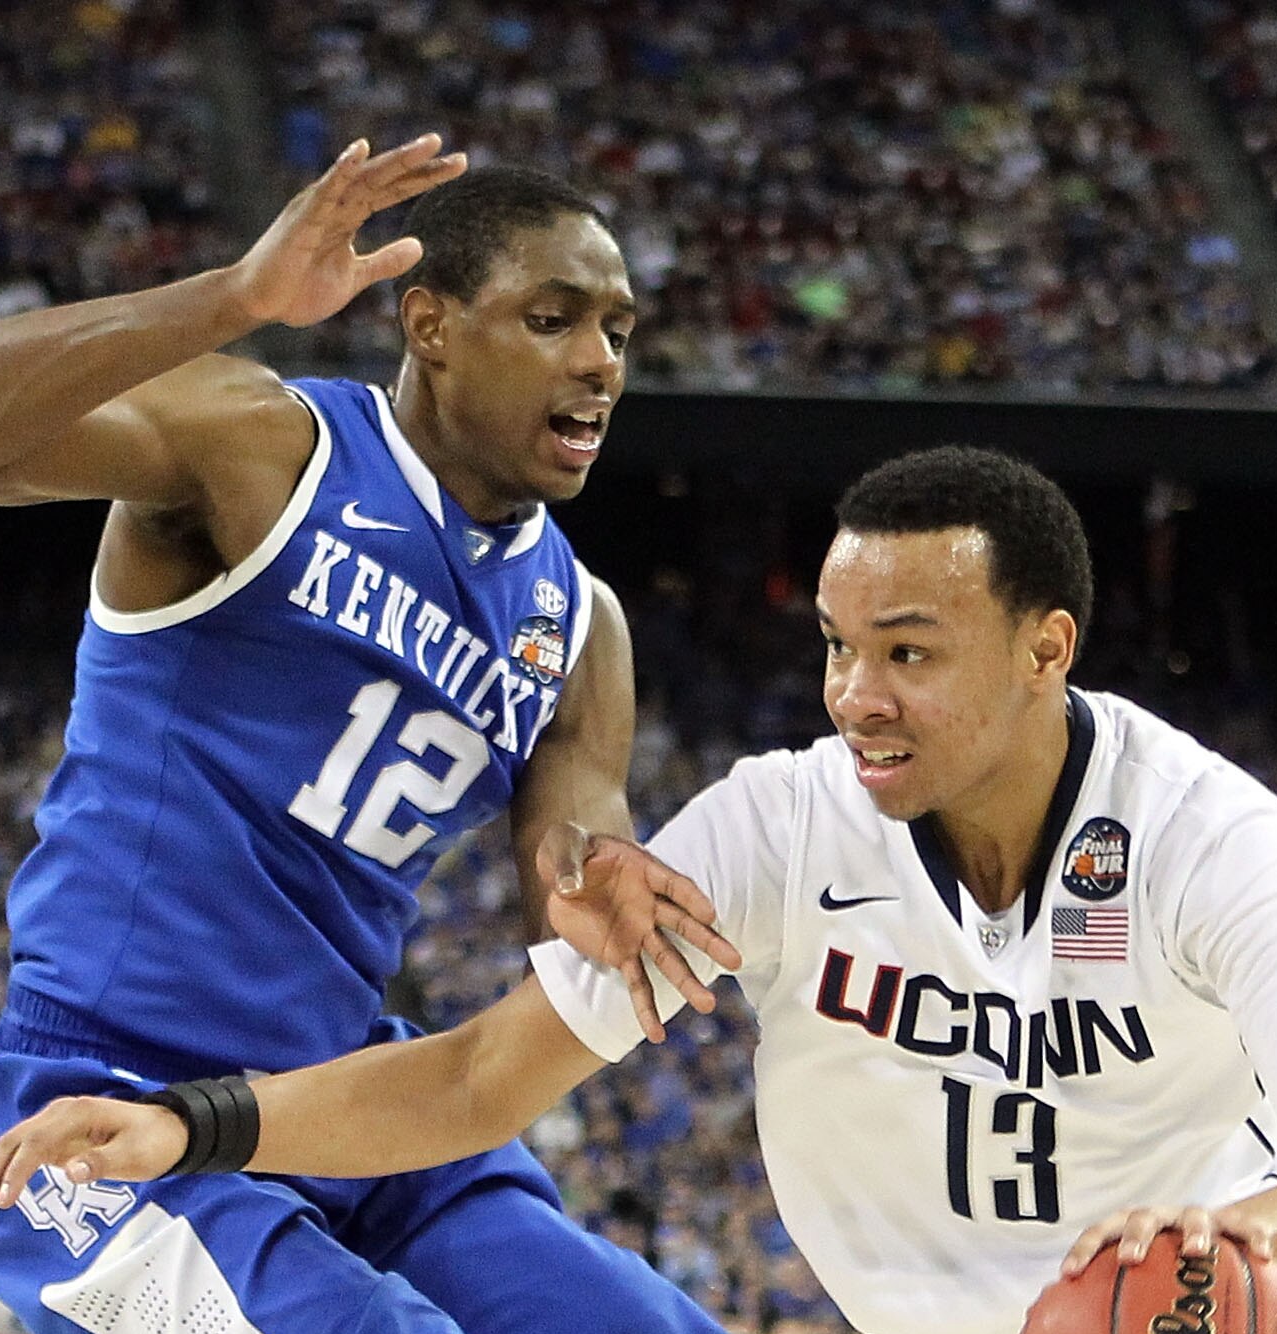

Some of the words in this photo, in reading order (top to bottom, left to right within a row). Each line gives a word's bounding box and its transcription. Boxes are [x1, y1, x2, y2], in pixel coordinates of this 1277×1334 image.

[534, 581, 567, 614] SEC
[287, 679, 491, 869] 12
[1081, 837, 1124, 855] FINAL
[816, 947, 1155, 1089] UCONN
[941, 1075, 1060, 1224] 13
